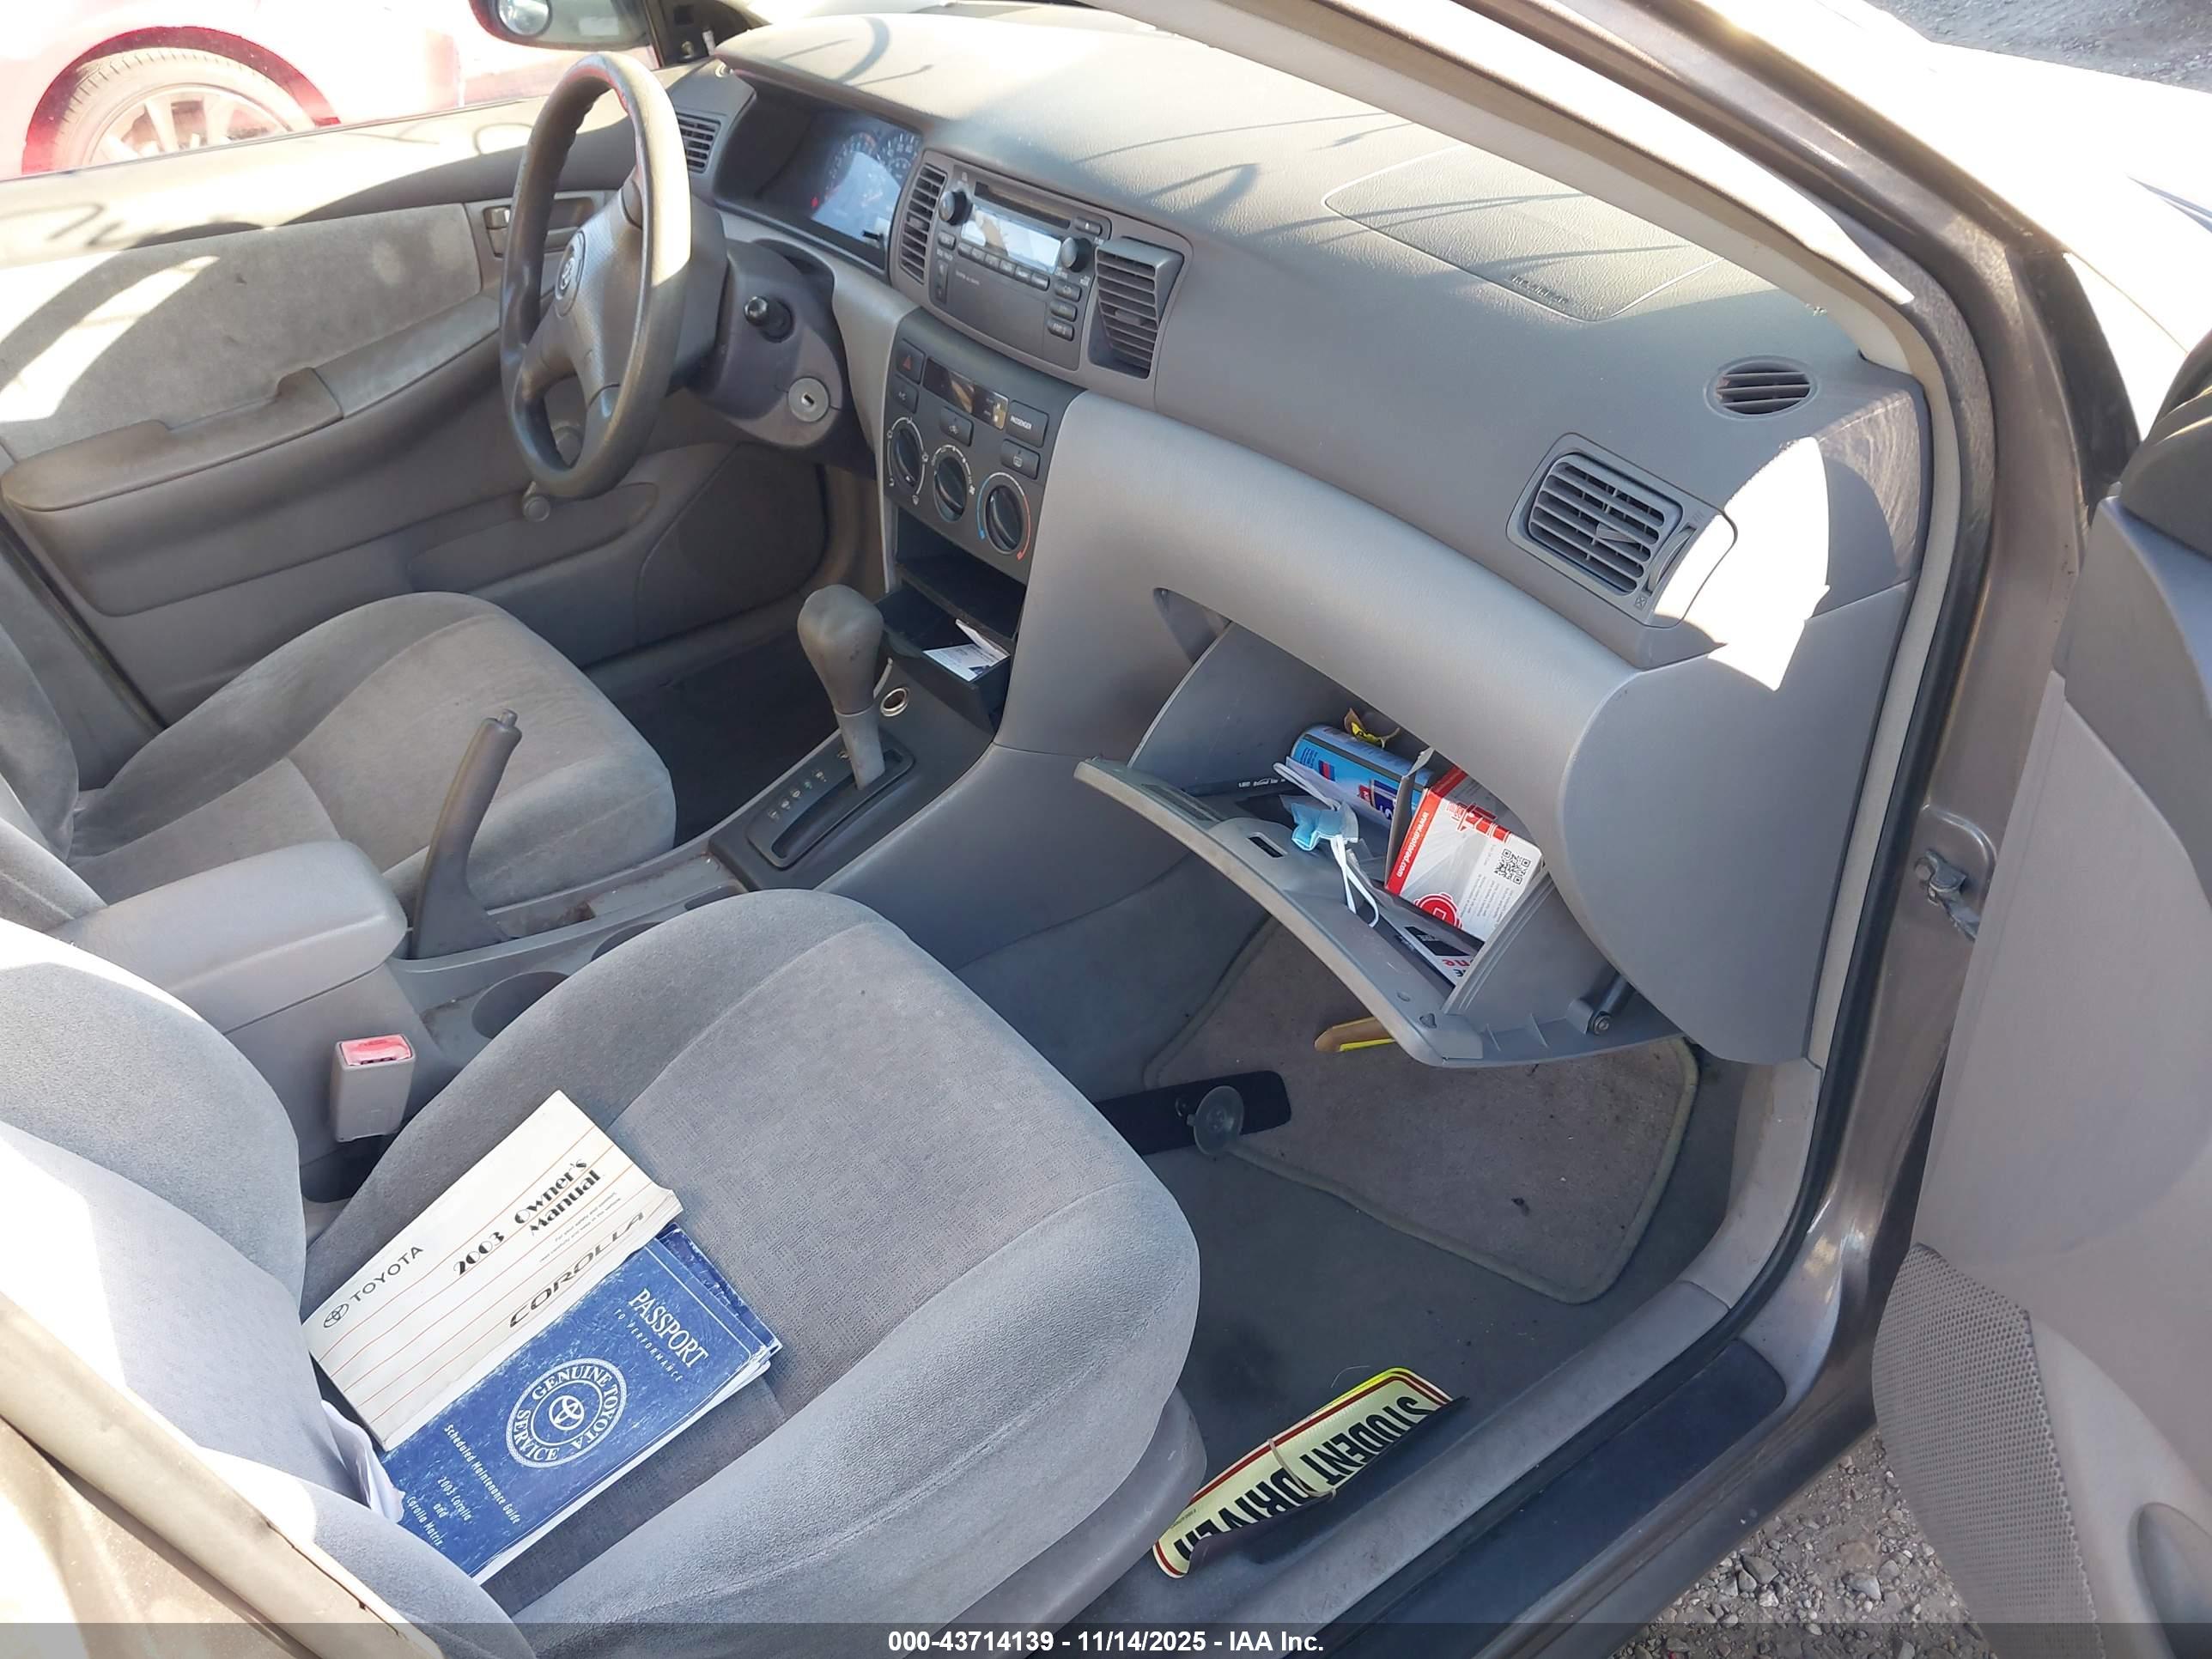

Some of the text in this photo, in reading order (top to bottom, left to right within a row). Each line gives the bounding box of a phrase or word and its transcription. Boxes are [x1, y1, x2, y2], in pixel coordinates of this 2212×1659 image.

[514, 1159, 586, 1224] Owner's
[529, 1170, 601, 1237] Manual
[349, 1246, 424, 1302] TOYOTA
[453, 1231, 505, 1275] 2003
[509, 1212, 644, 1328] COROLLA
[614, 1309, 684, 1382] TO PERFORMANCE
[628, 1288, 709, 1369] PASSPORT
[514, 1364, 618, 1462] GENUINE TOYOTA SERVICE
[1299, 1396, 1440, 1485] STUDENT
[437, 1475, 472, 1522] 2003 Corolla
[443, 1423, 521, 1524] Scheduled Maintenance Guide
[407, 1496, 444, 1547] Corolla Matrix
[433, 1503, 449, 1518] and
